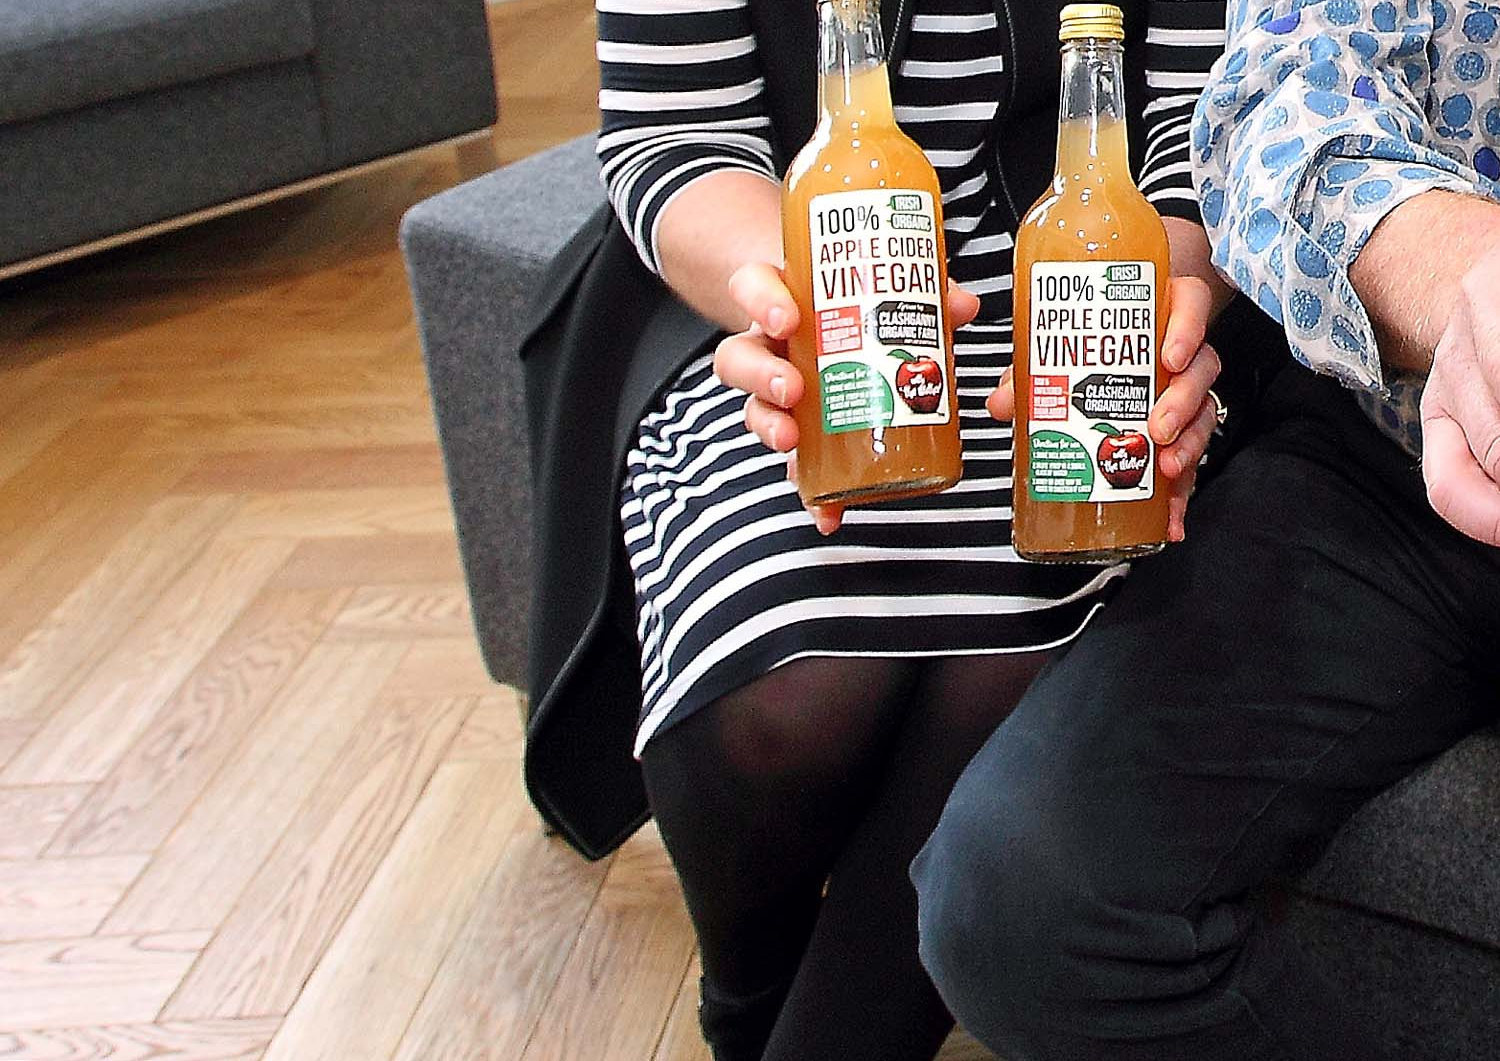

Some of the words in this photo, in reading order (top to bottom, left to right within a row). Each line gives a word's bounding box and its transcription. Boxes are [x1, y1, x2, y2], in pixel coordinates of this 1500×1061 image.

[818, 205, 880, 236] 100%
[820, 237, 881, 264] APPLE
[888, 237, 935, 259] CIDER
[821, 263, 936, 299] VINEGAR
[1036, 275, 1094, 301] 100%
[1111, 265, 1139, 281] IRISH
[1107, 285, 1150, 300] ORGANIC
[1036, 308, 1093, 330] APPLE
[1100, 308, 1151, 330] CIDER
[1036, 334, 1150, 366] VINEGAR
